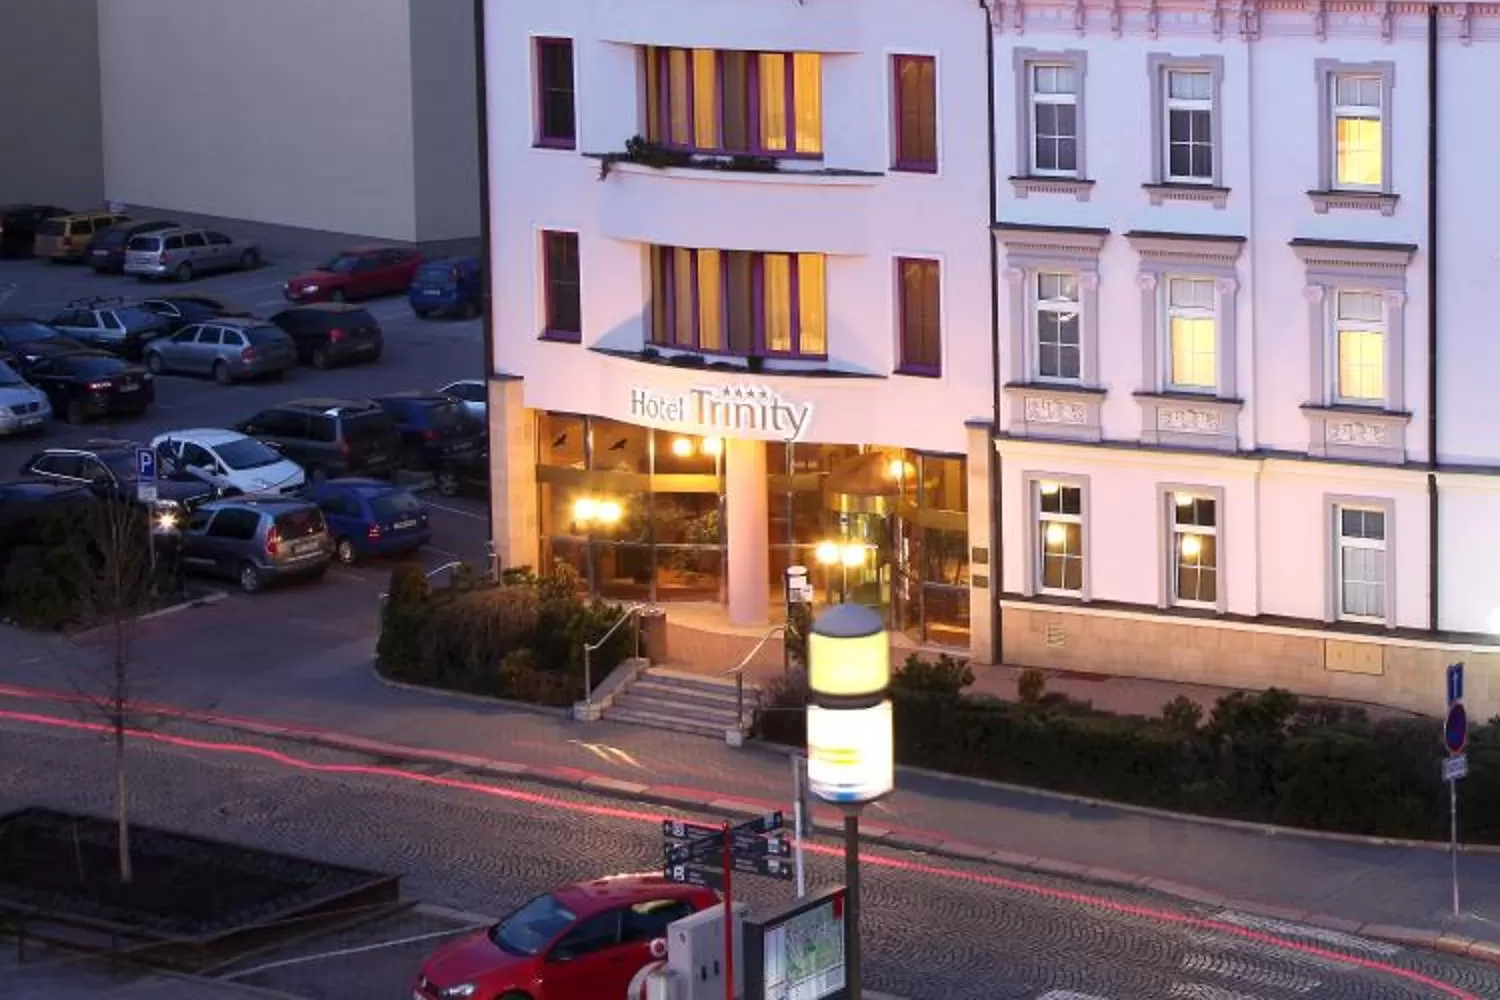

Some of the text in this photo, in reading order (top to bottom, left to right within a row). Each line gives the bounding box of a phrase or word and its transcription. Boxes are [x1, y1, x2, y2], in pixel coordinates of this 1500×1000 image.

[631, 387, 809, 441] Hotel Trinity
[140, 452, 152, 473] P
